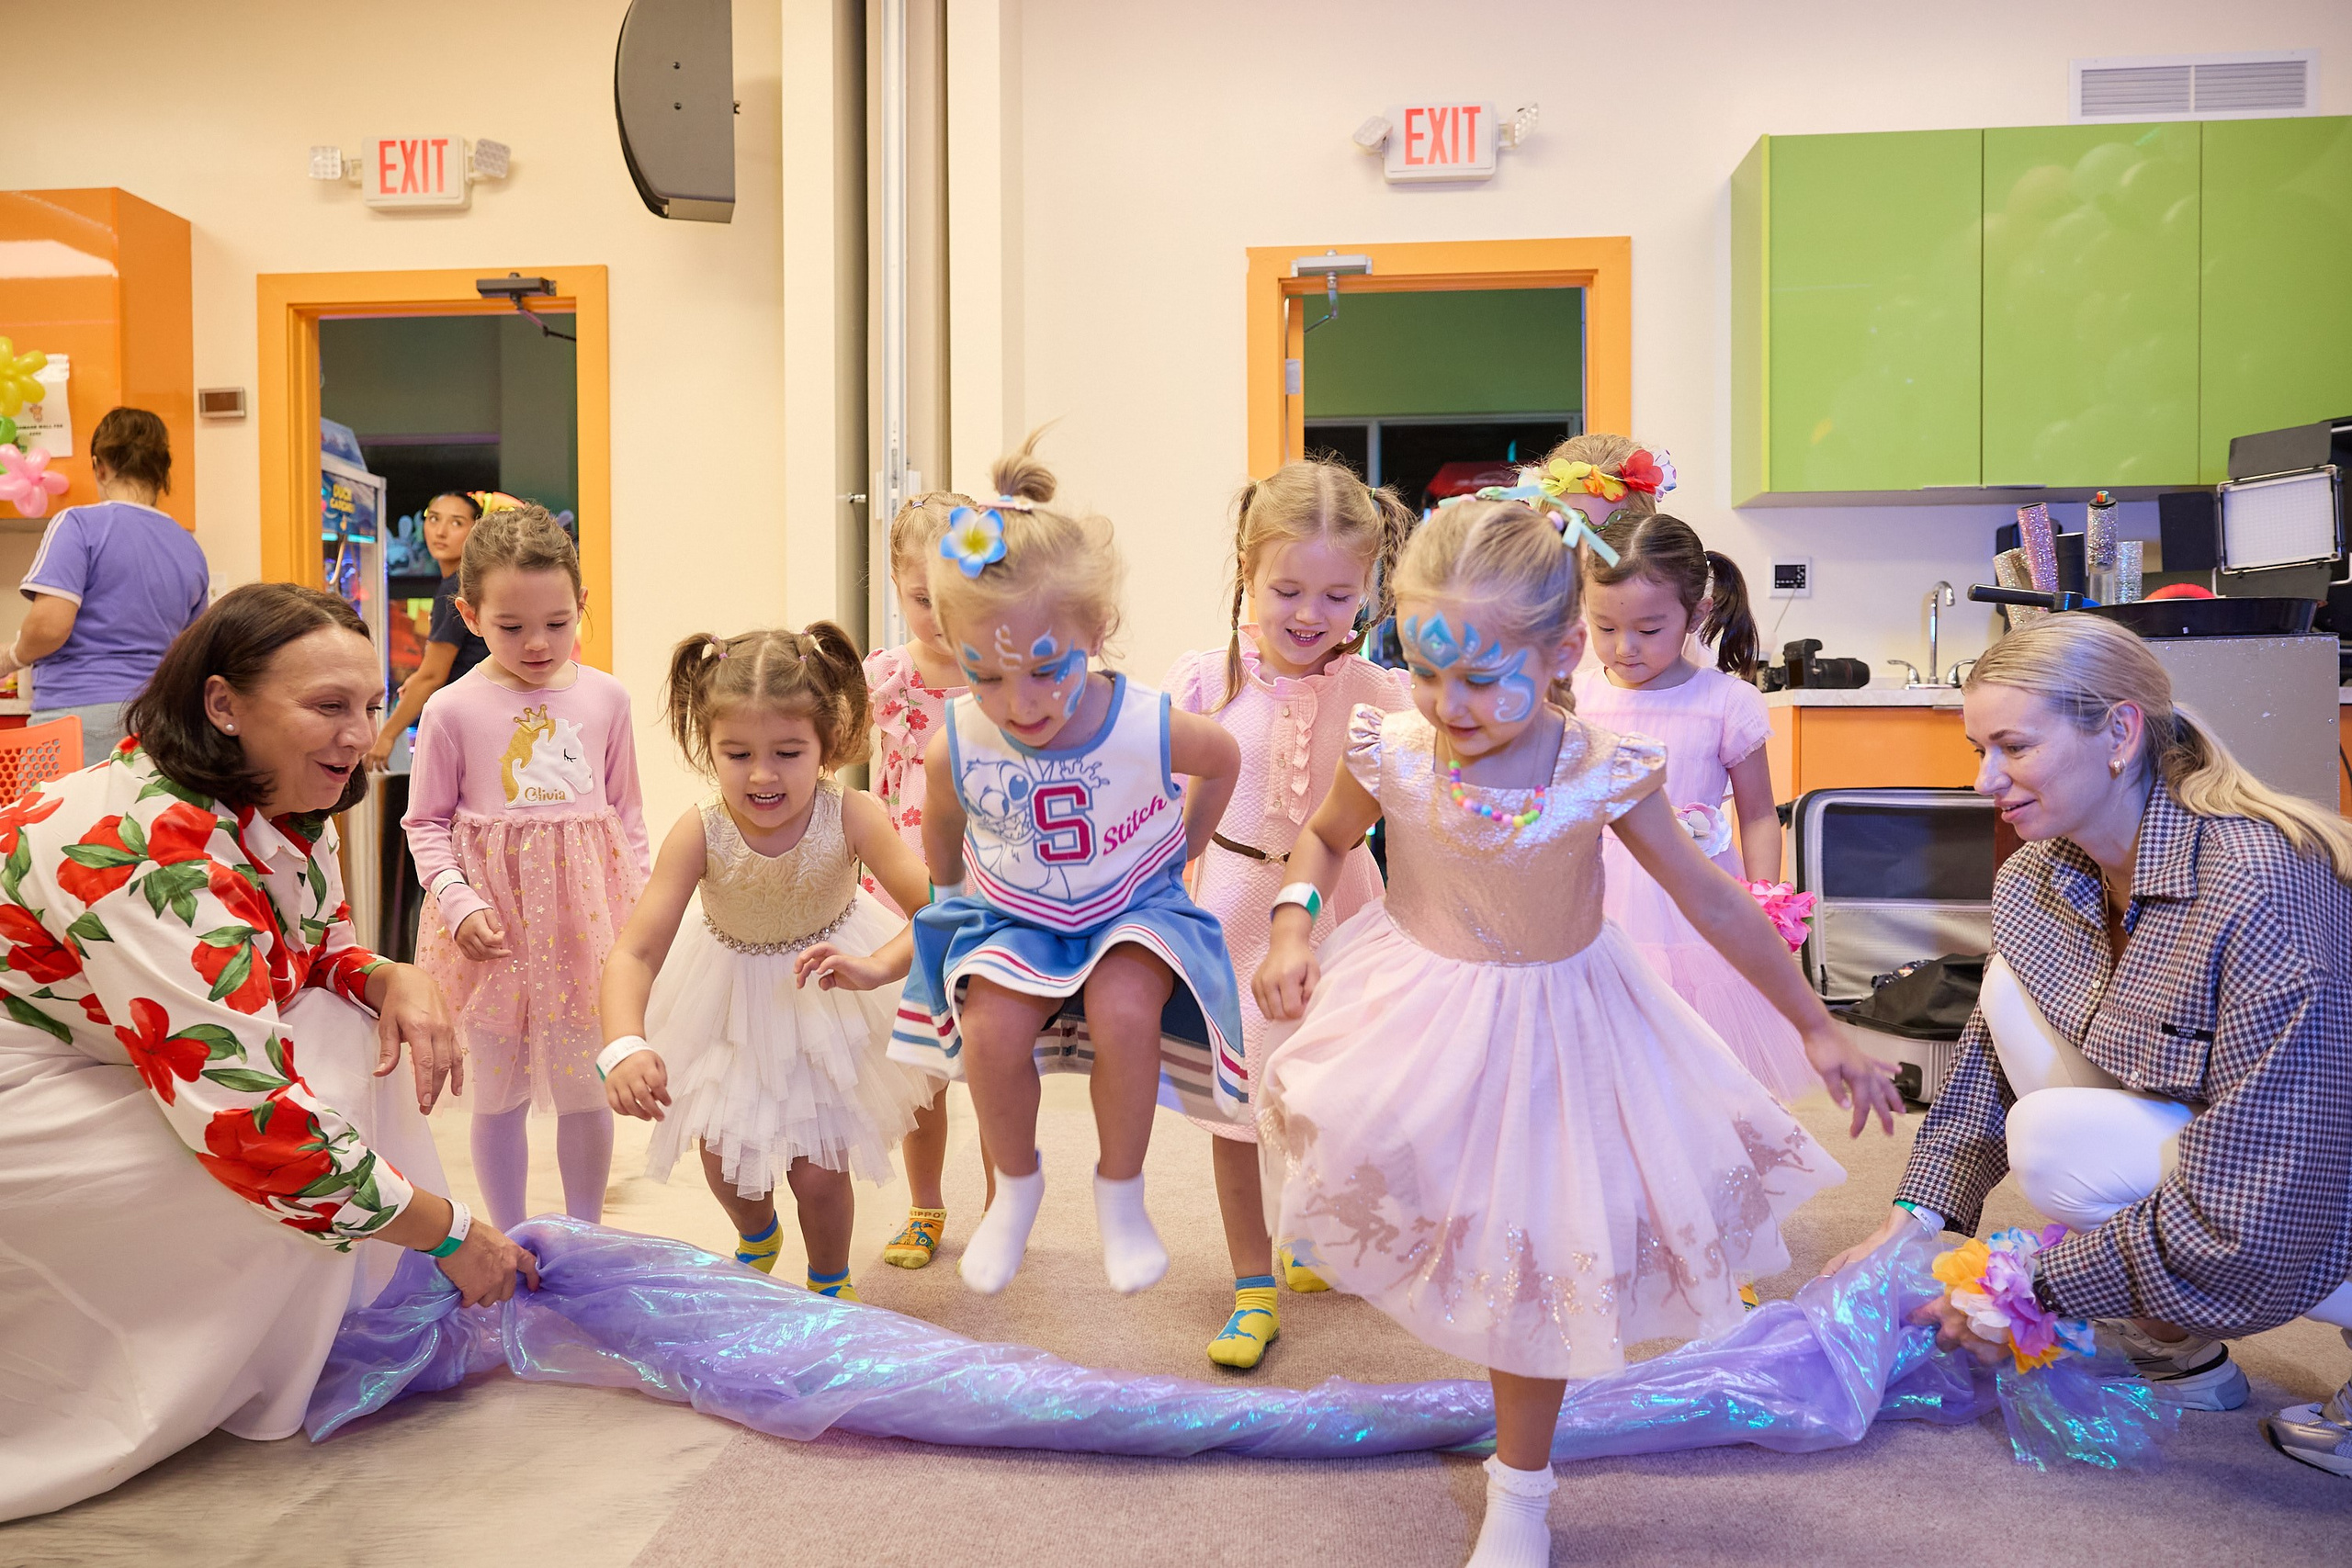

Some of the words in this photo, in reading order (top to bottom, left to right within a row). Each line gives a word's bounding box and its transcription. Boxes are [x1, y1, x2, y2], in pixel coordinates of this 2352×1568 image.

[1405, 106, 1481, 165] EXIT
[379, 139, 448, 195] EXIT
[524, 786, 566, 802] Olivia
[1028, 778, 1097, 867] S
[1103, 795, 1168, 857] Stitch
